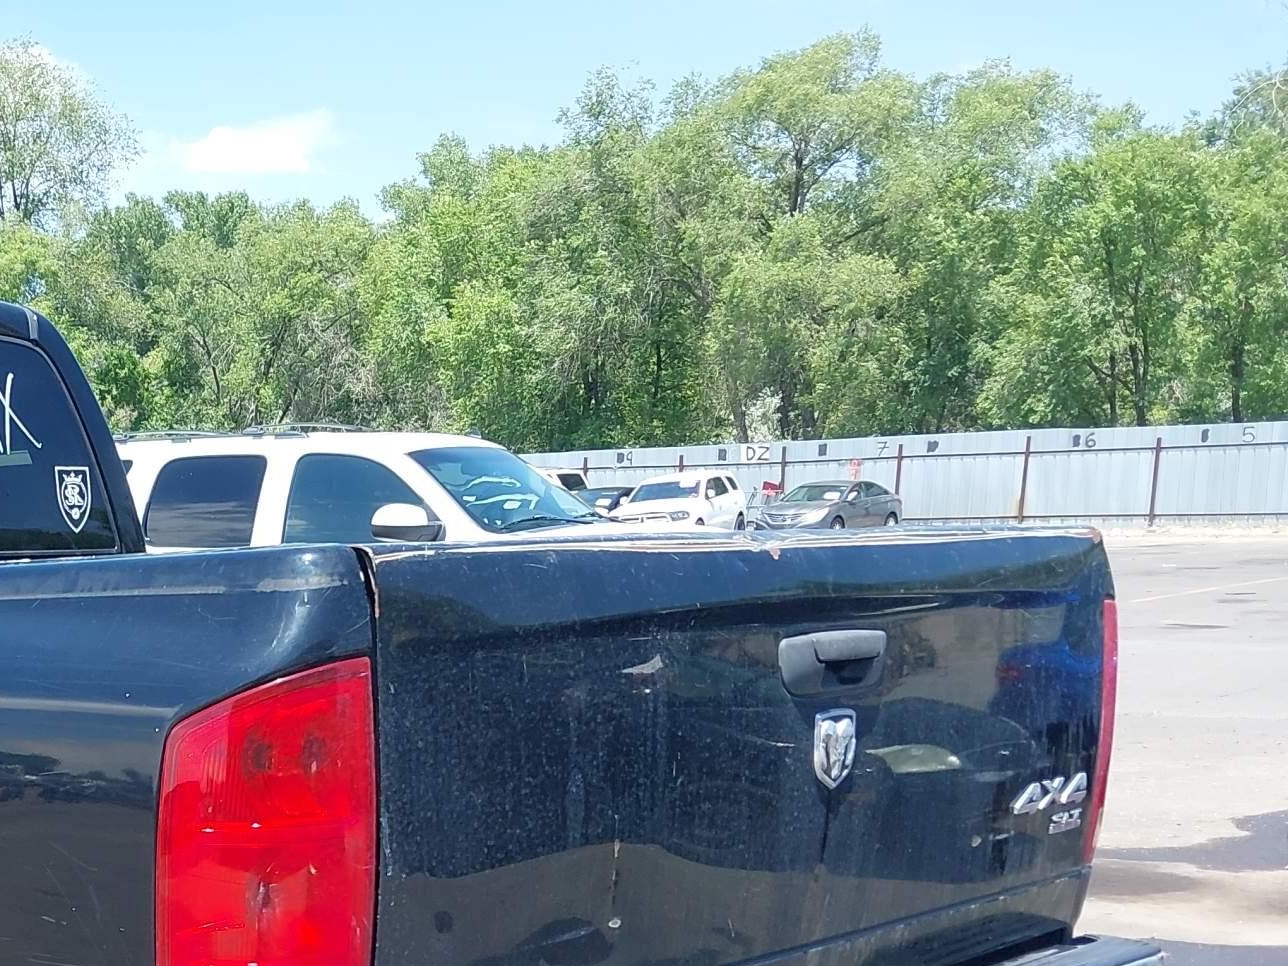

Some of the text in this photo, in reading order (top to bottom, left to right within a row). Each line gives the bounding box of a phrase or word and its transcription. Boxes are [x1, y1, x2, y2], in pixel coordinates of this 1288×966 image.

[1085, 432, 1097, 448] 6
[1242, 426, 1256, 443] 5
[876, 441, 890, 456] 7
